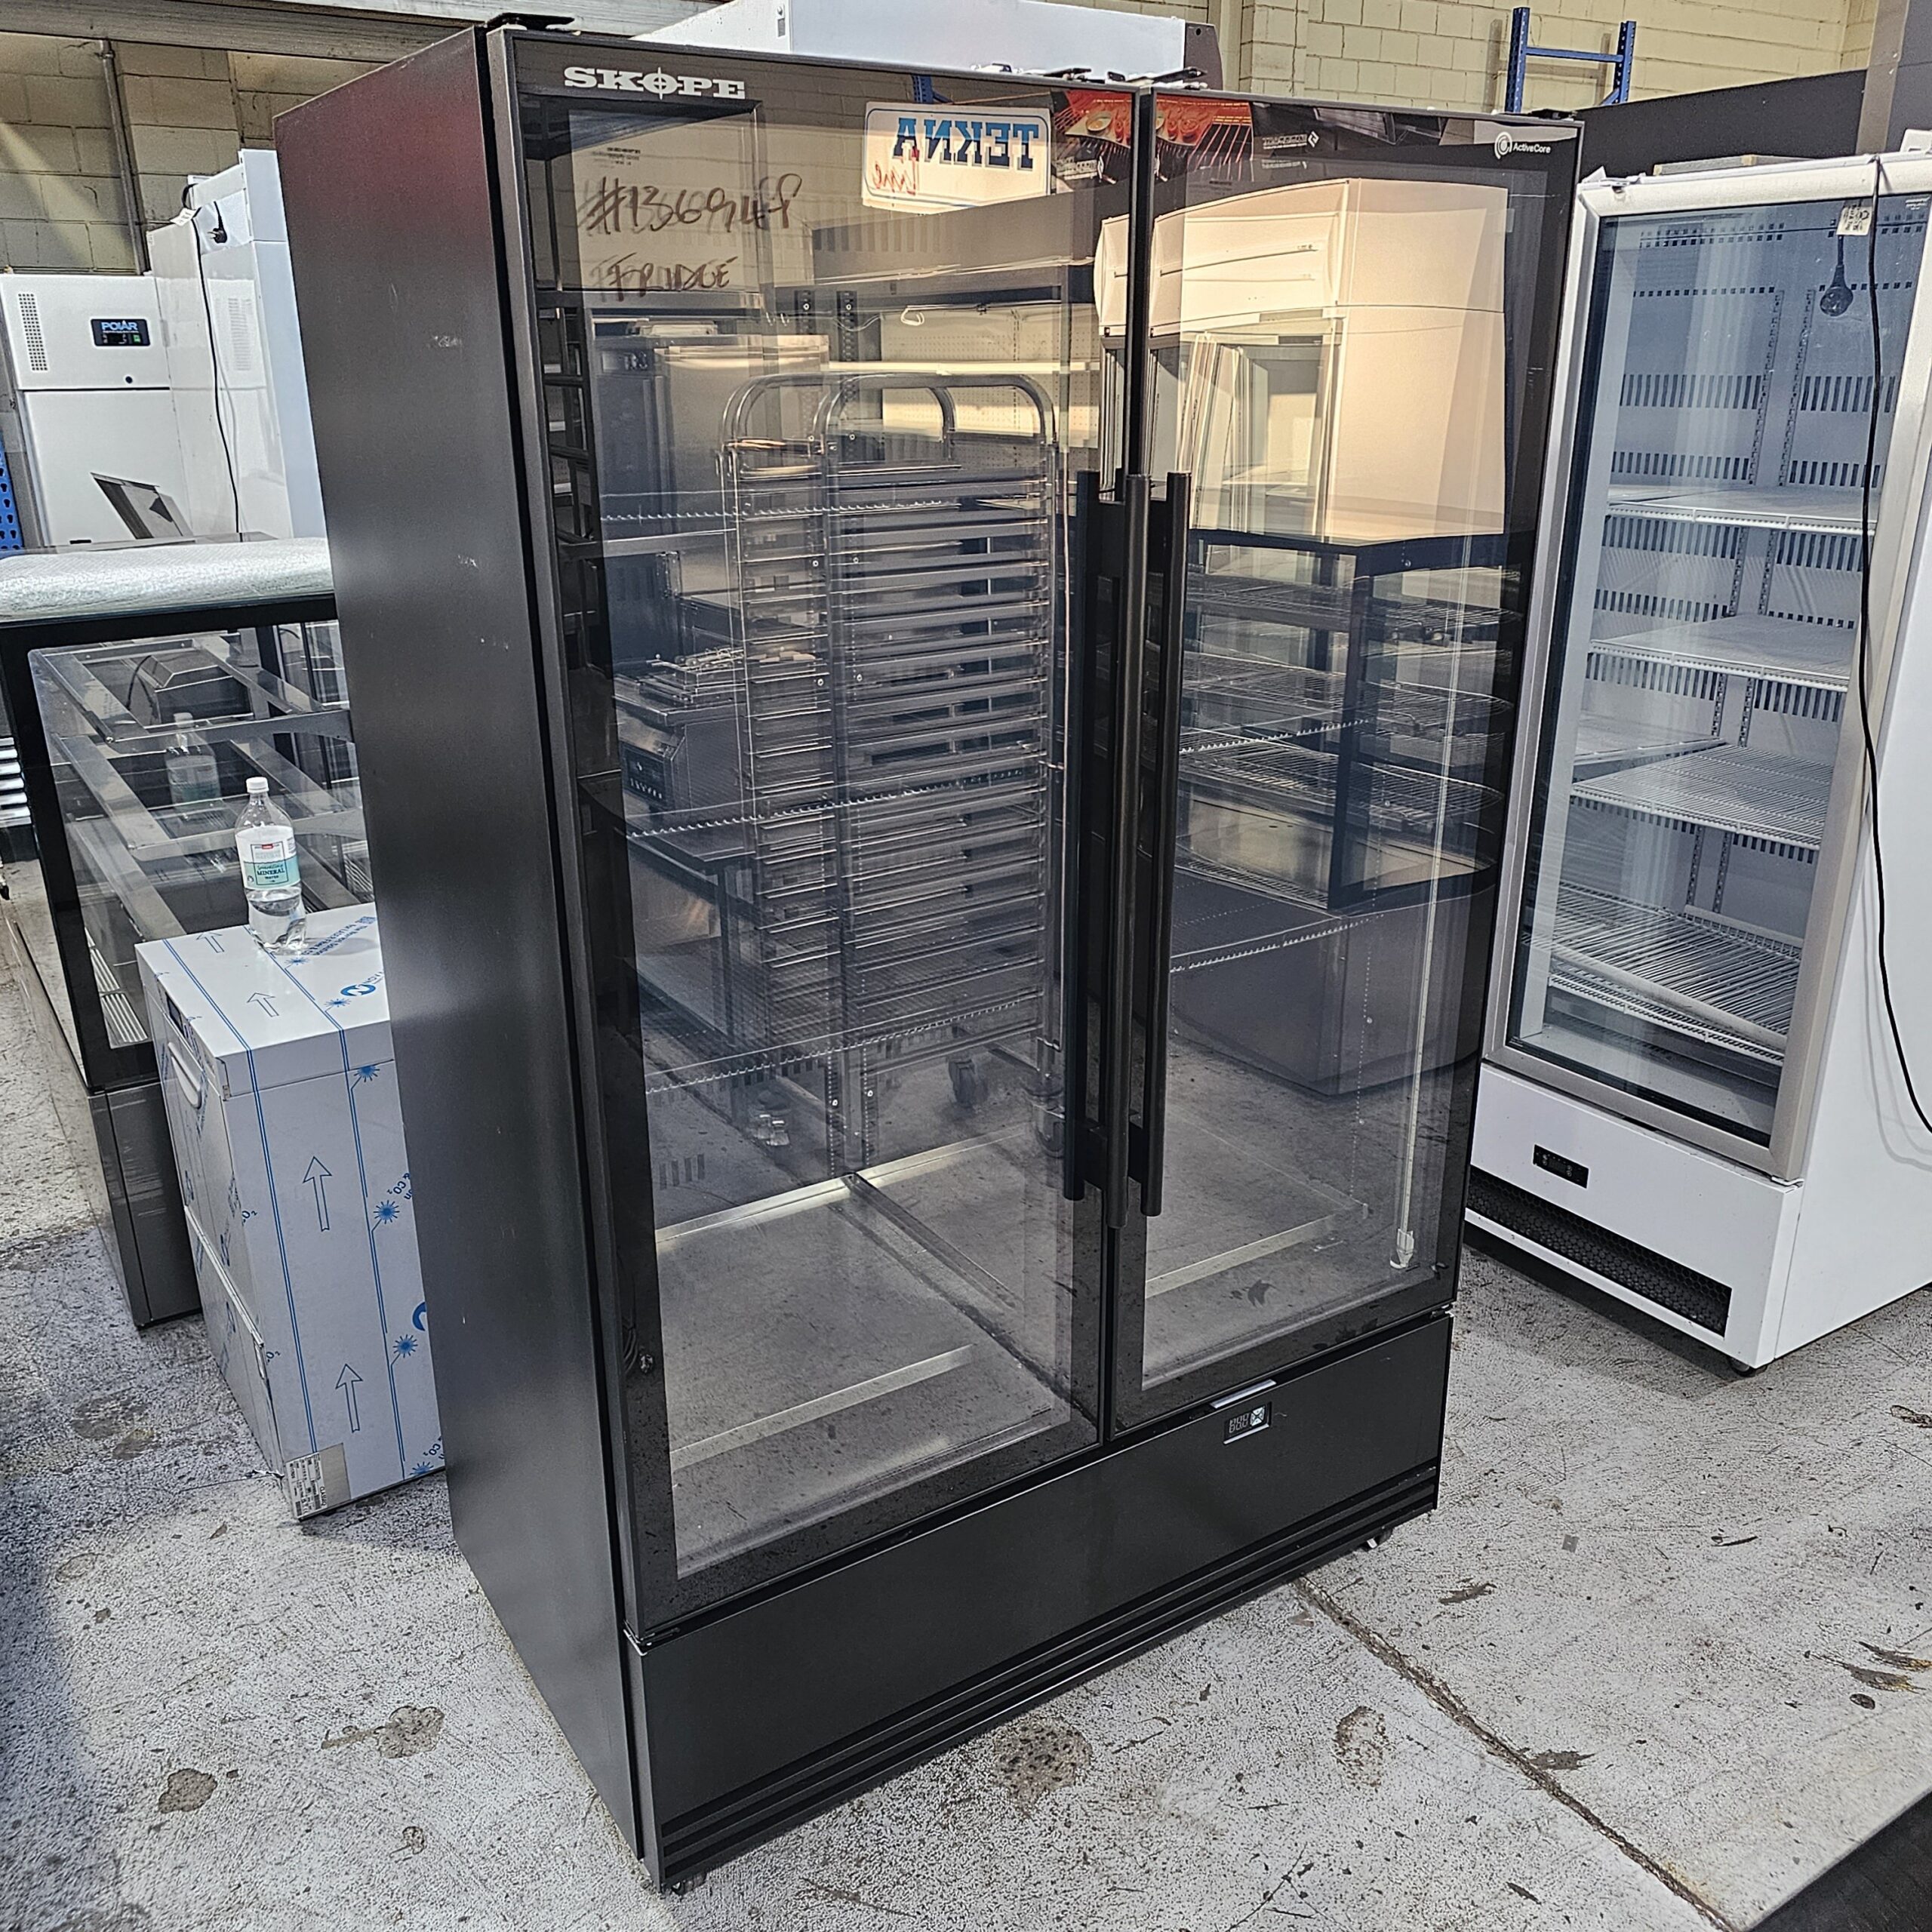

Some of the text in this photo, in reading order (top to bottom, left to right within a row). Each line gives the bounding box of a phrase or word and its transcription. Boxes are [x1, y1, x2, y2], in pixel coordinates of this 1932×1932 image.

[564, 66, 746, 100] SKOPE
[1513, 143, 1552, 154] ActiveCore
[101, 320, 138, 331] POLAR
